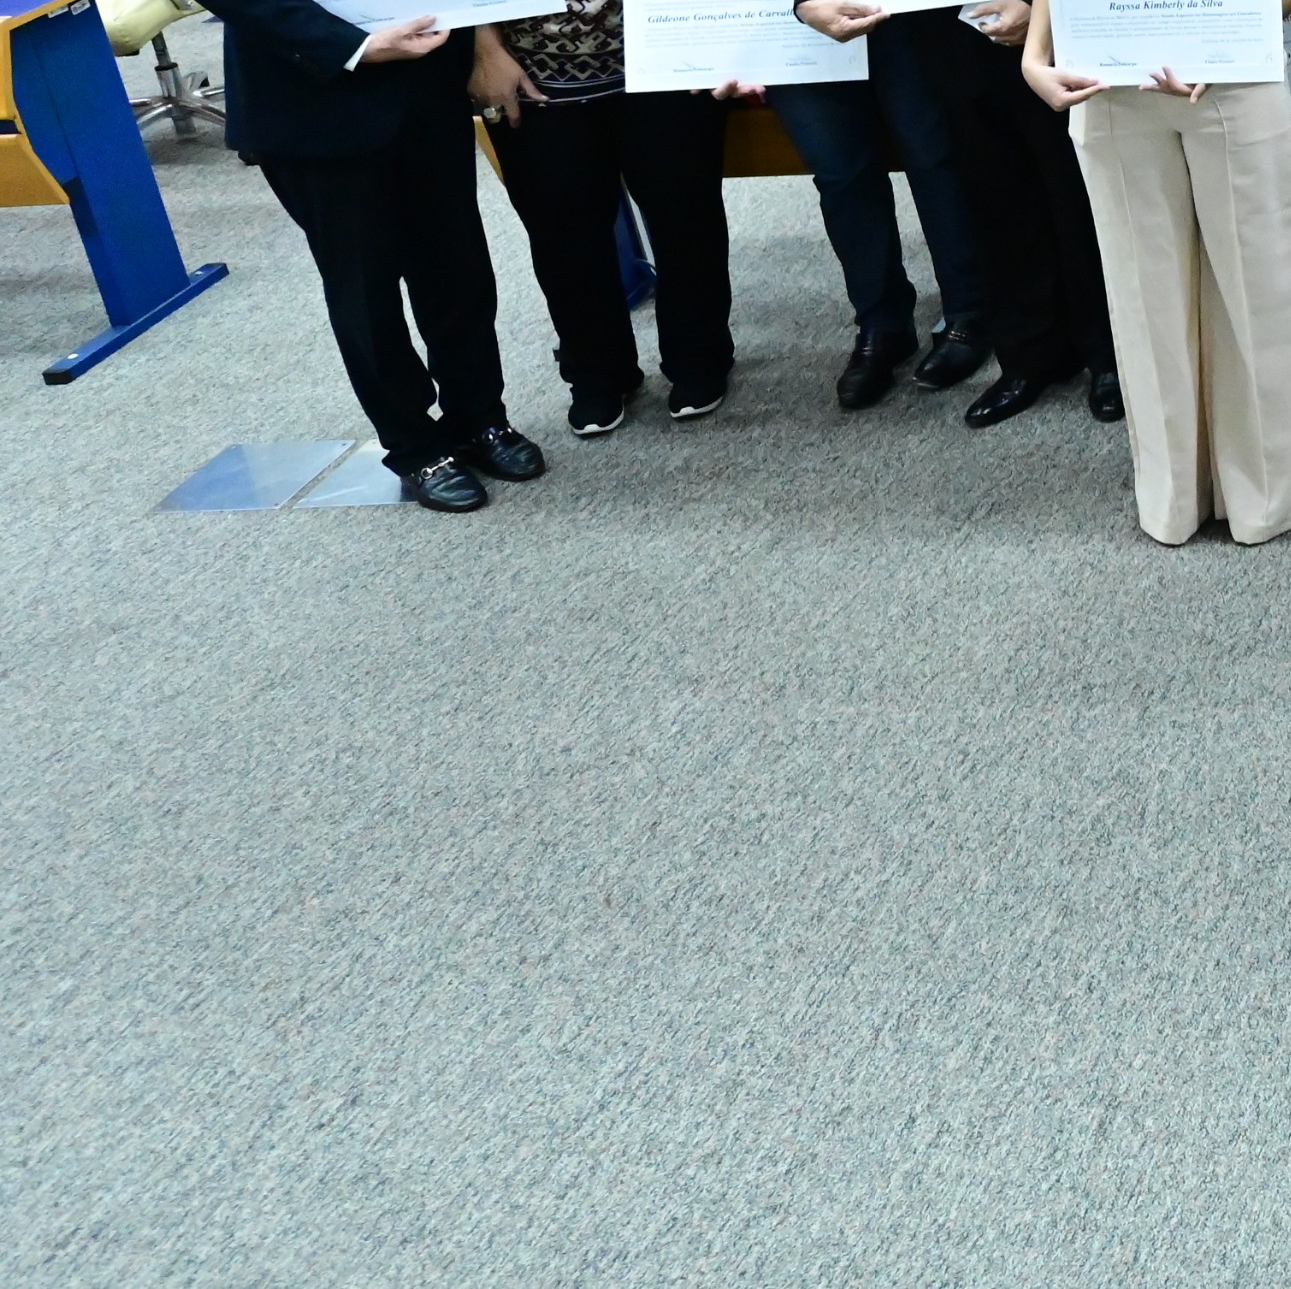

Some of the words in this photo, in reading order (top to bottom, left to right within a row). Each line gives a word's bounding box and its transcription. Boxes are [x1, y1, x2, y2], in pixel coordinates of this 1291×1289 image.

[1109, 2, 1140, 12] Rayssa
[1143, 0, 1185, 9] Kimberly
[1186, 0, 1198, 8] da
[693, 11, 742, 22] Gonçalves
[744, 10, 755, 19] de
[758, 9, 794, 17] Carval
